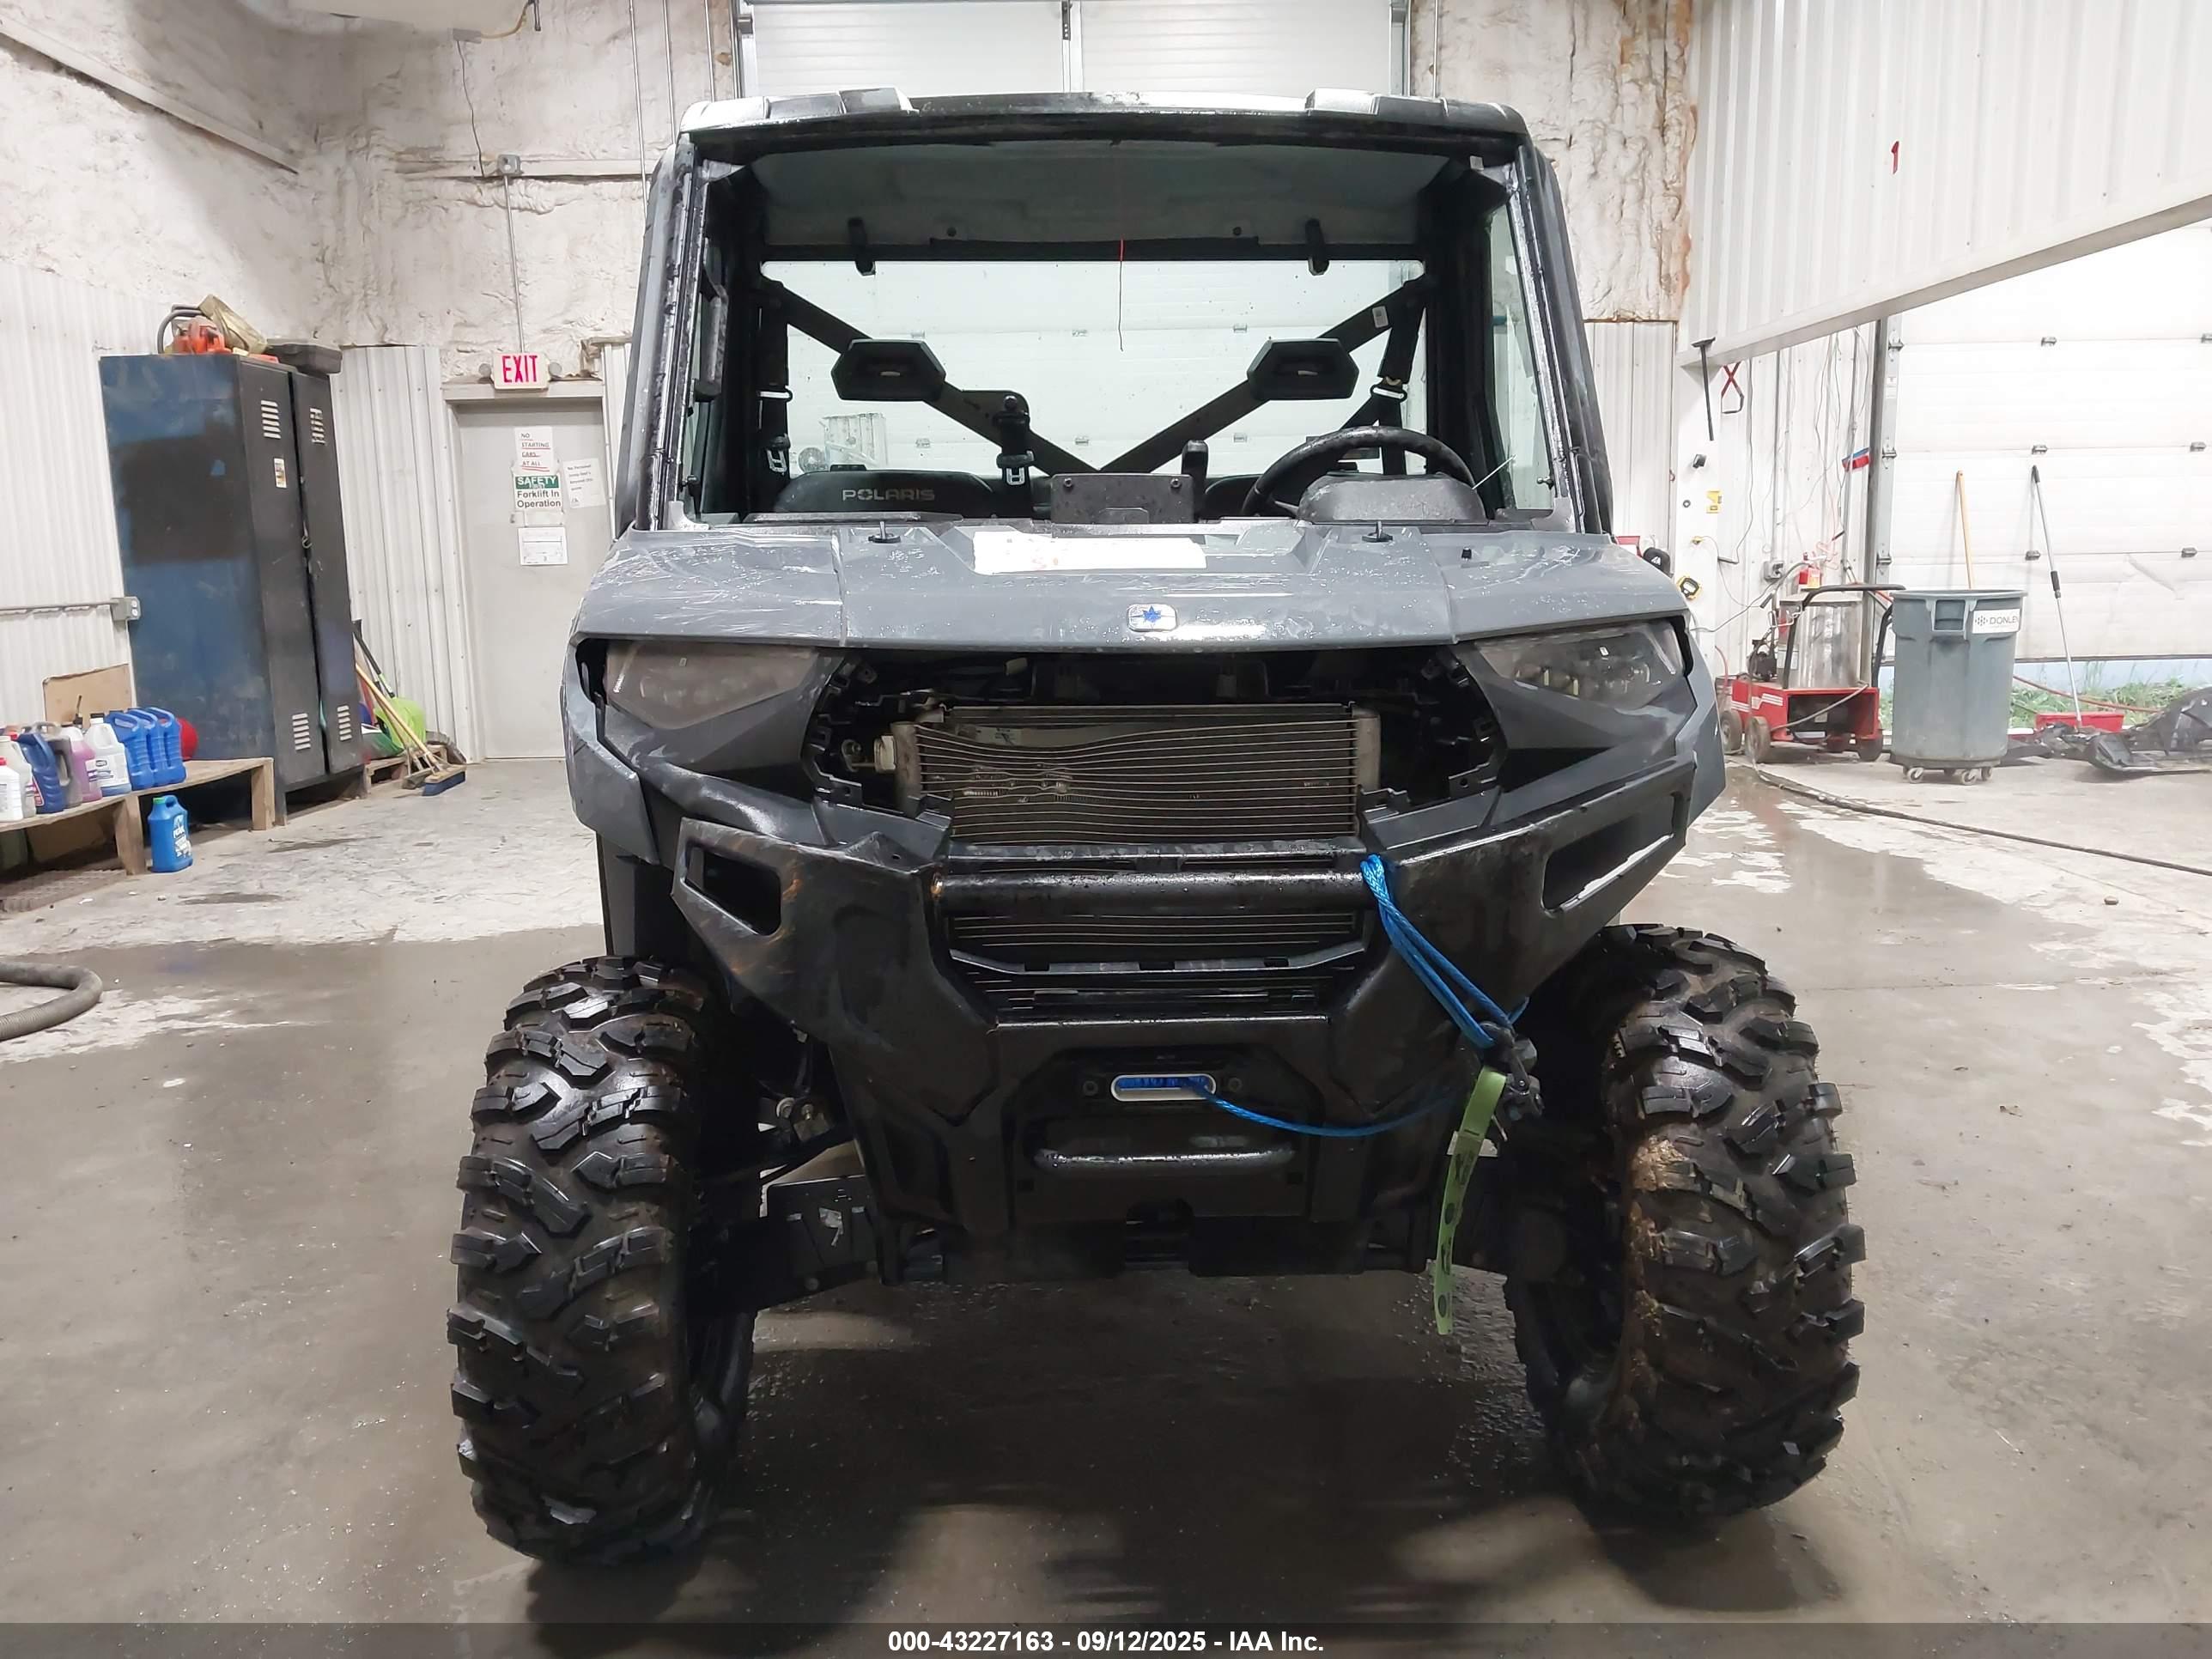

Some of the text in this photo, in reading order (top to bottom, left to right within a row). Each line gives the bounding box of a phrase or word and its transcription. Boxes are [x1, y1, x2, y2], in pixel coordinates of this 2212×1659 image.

[501, 355, 538, 383] EXIT
[517, 477, 556, 486] SAFETY
[517, 489, 560, 499] Forklift In
[842, 488, 935, 501] POLARIS
[517, 499, 562, 509] Operation
